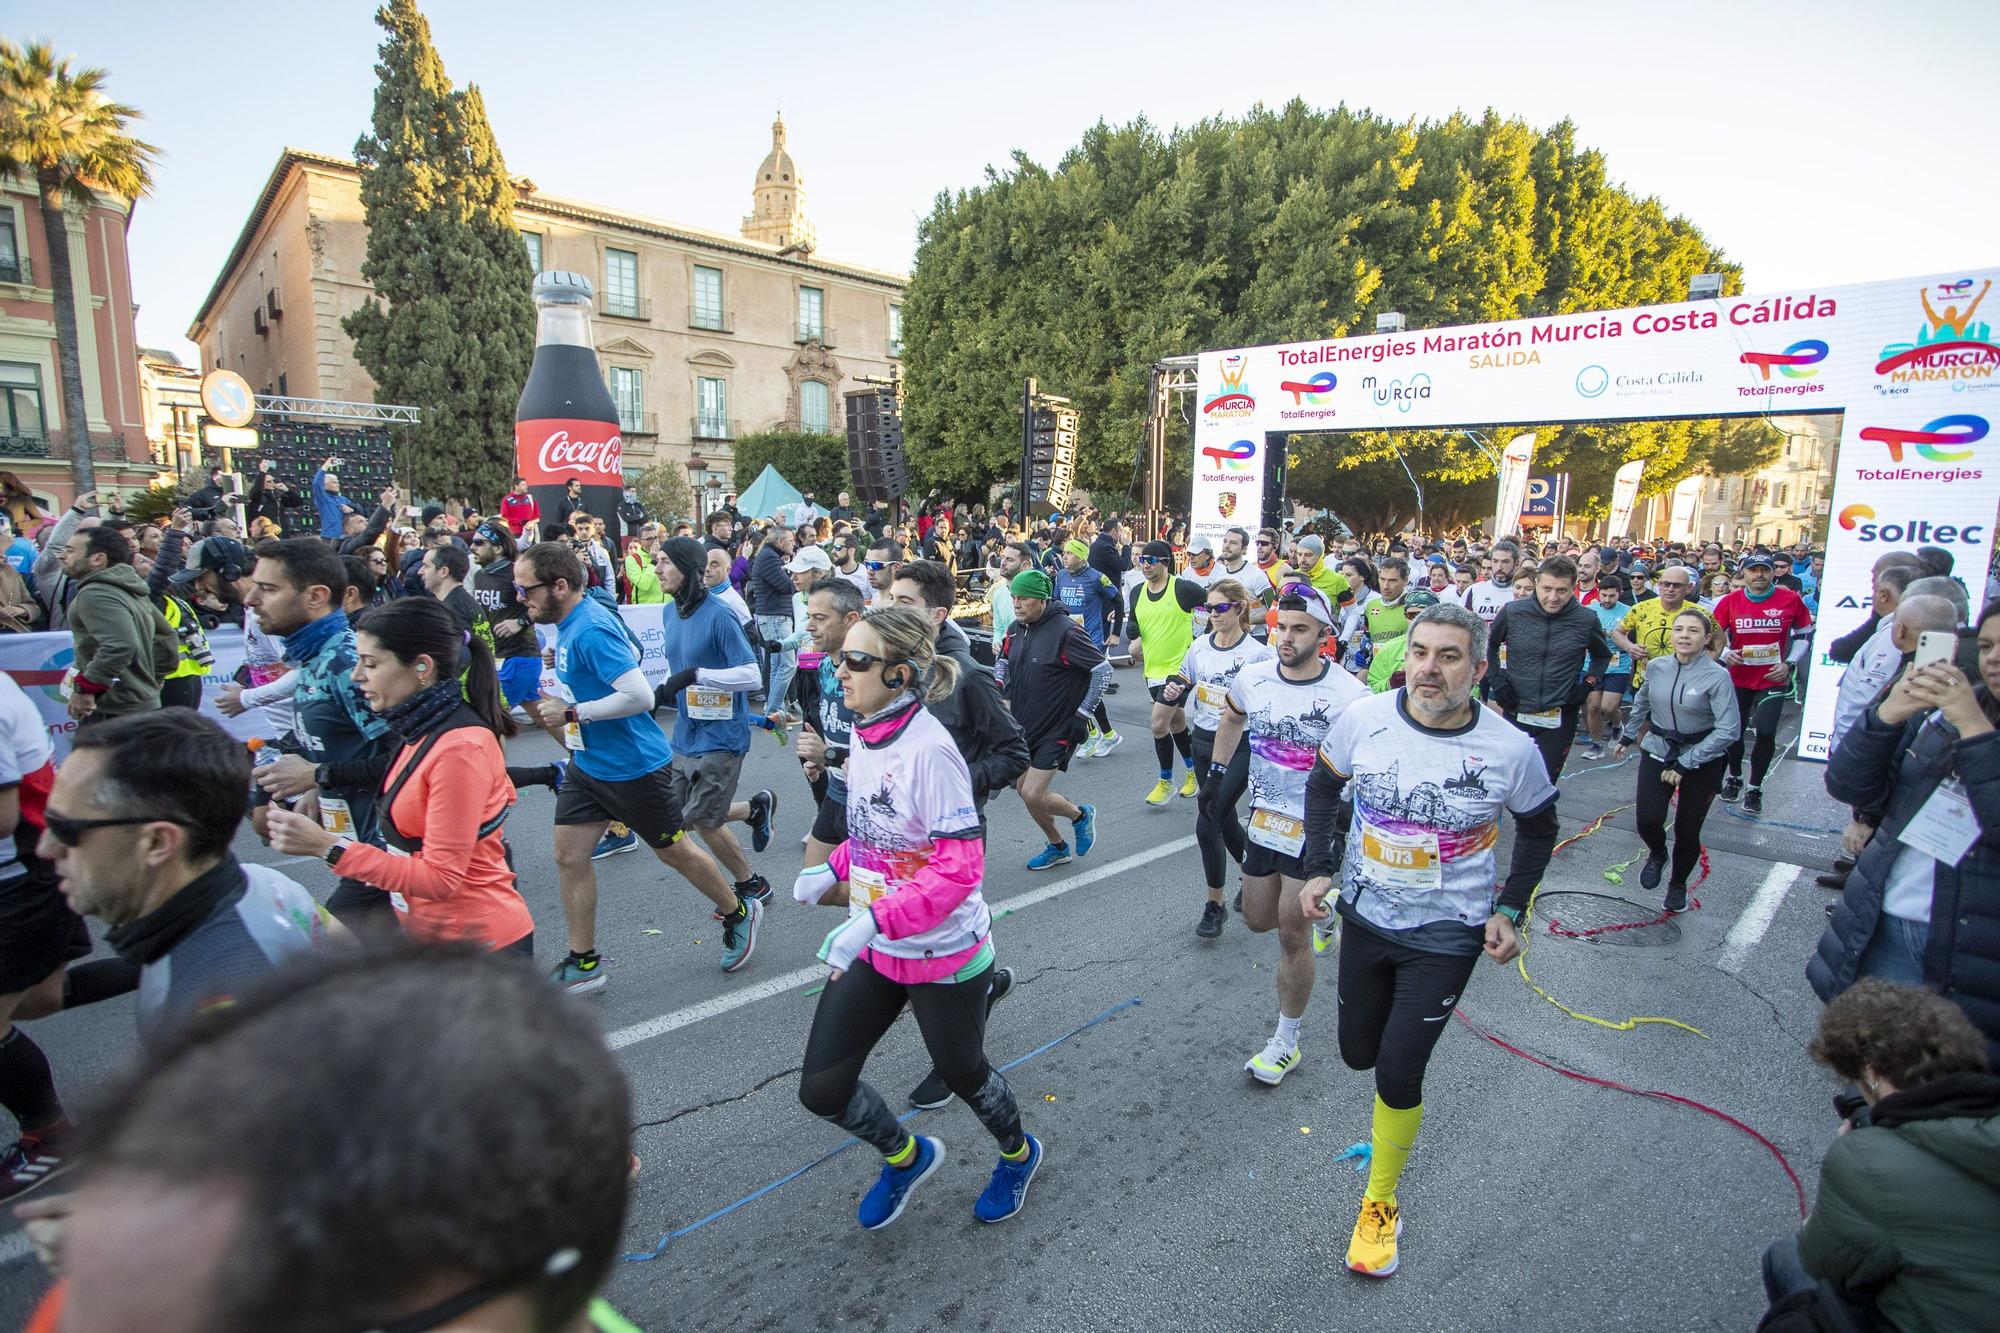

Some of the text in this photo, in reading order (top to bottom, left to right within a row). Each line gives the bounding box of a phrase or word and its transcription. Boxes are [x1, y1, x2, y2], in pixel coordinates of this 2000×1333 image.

[1277, 294, 1837, 367] TotalEnergies Maratón Murcia Costa Cálida
[1469, 349, 1542, 370] SALIDA
[1616, 375, 1653, 387] Costa
[1737, 383, 1825, 397] TotalEnergies
[1280, 408, 1336, 420] TotalEnergies
[1202, 473, 1255, 483] TotalEnergies
[1855, 467, 1982, 482] TotalEnergies
[1522, 478, 1550, 512] P
[1857, 520, 1984, 544] soltec
[1735, 618, 1753, 628] 90
[697, 694, 721, 705] 5254
[1264, 814, 1293, 834] 5503
